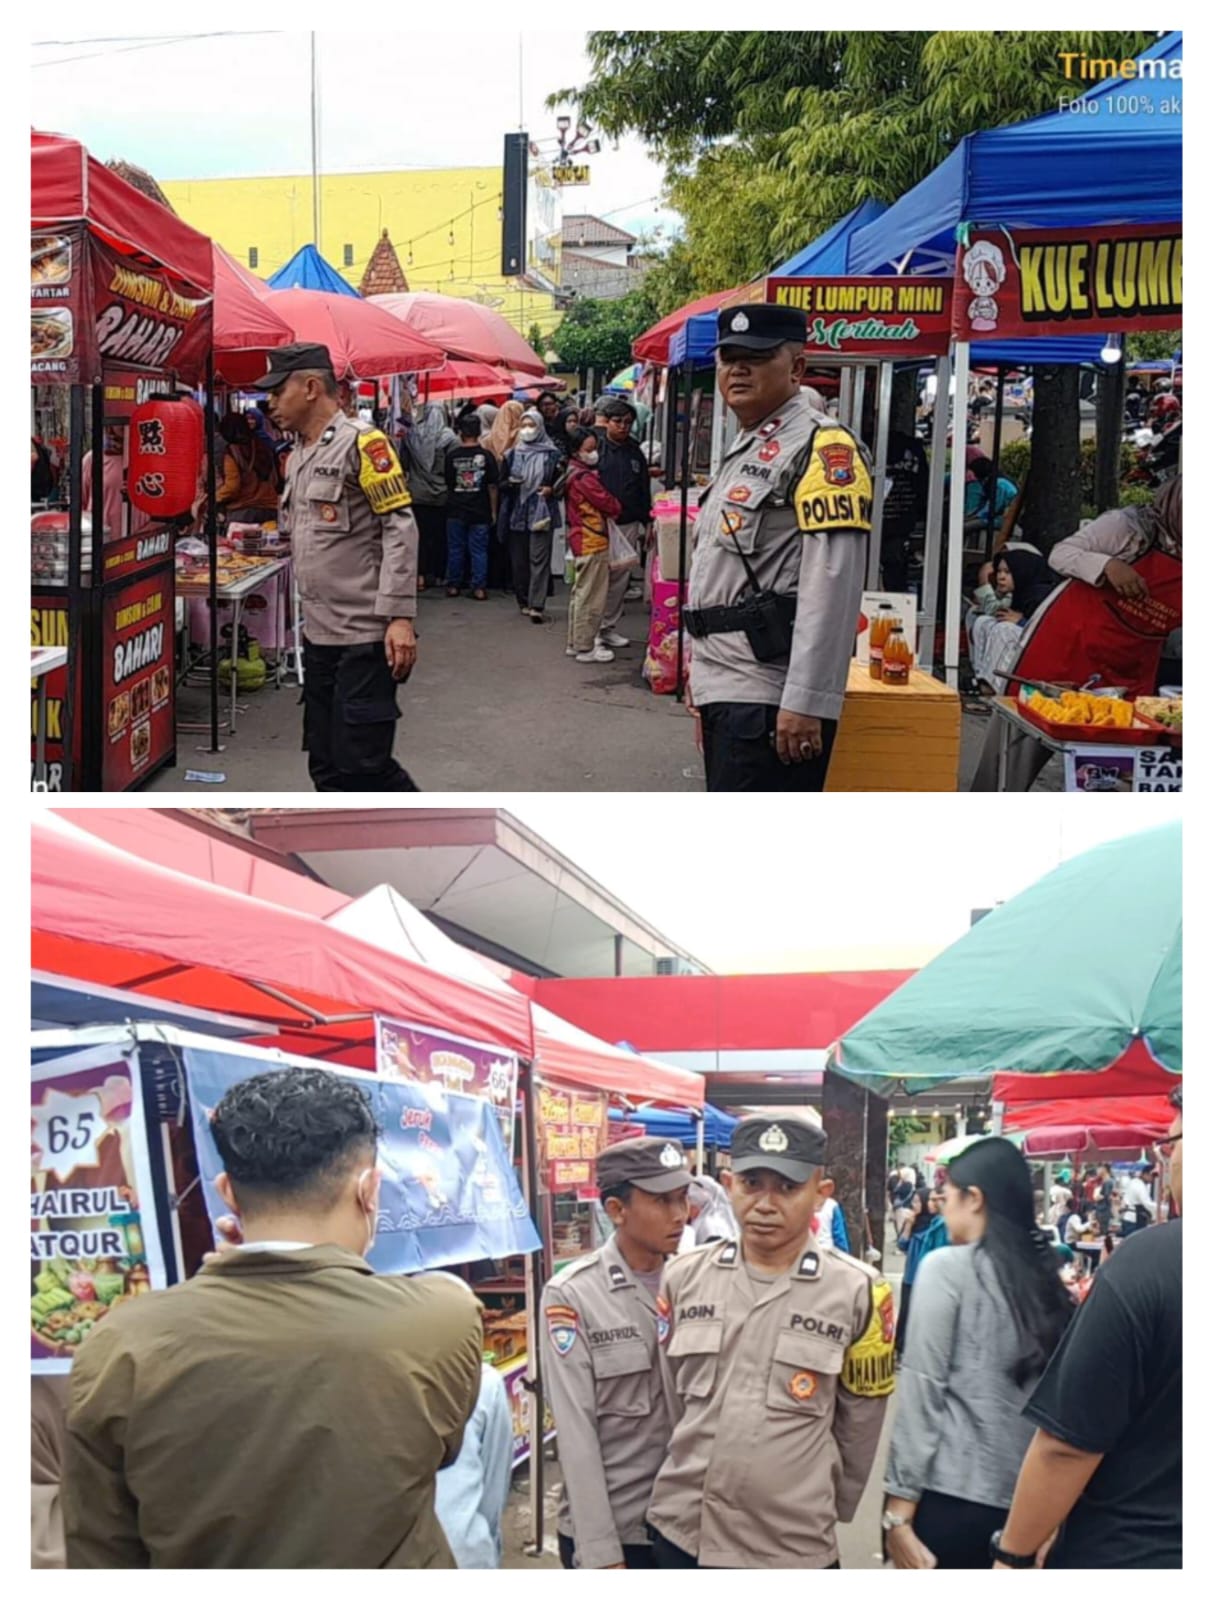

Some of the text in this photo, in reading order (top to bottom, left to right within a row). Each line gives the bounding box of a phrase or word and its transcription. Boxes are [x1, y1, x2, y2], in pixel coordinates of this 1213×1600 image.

[1021, 244, 1088, 312] KUE
[776, 286, 943, 311] KUE LUMPUR MINI
[96, 305, 183, 367] BAHARI
[740, 464, 772, 480] POLRI
[802, 494, 854, 527] POLISI
[114, 622, 164, 682] BAHARI
[48, 1112, 94, 1154] 65
[679, 1304, 715, 1321] AGIN
[790, 1314, 844, 1340] POLRI
